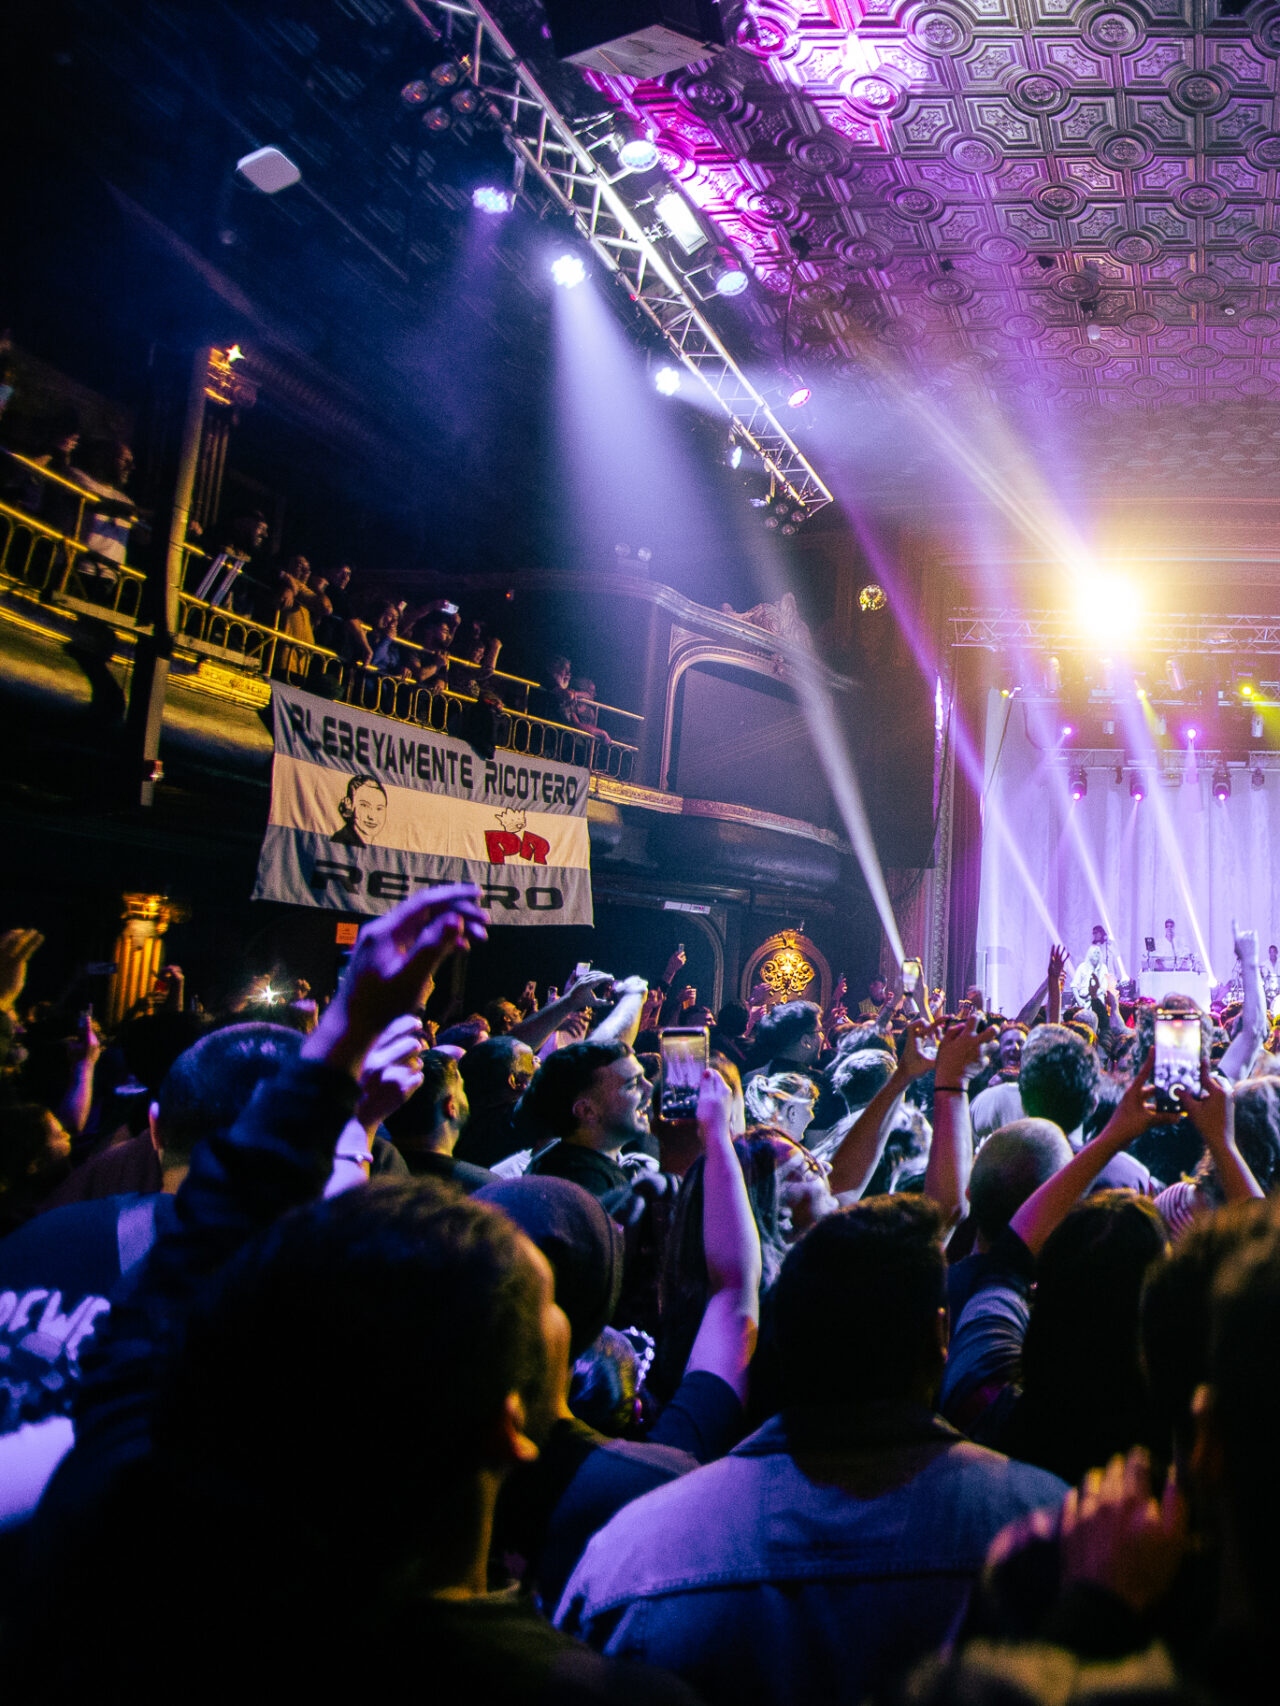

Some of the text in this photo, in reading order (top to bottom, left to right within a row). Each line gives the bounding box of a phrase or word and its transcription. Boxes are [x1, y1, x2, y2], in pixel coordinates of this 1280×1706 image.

[289, 702, 578, 806] PLEBEYAMENTE RICOTERO
[484, 829, 551, 865] PR
[310, 859, 564, 911] RETRO
